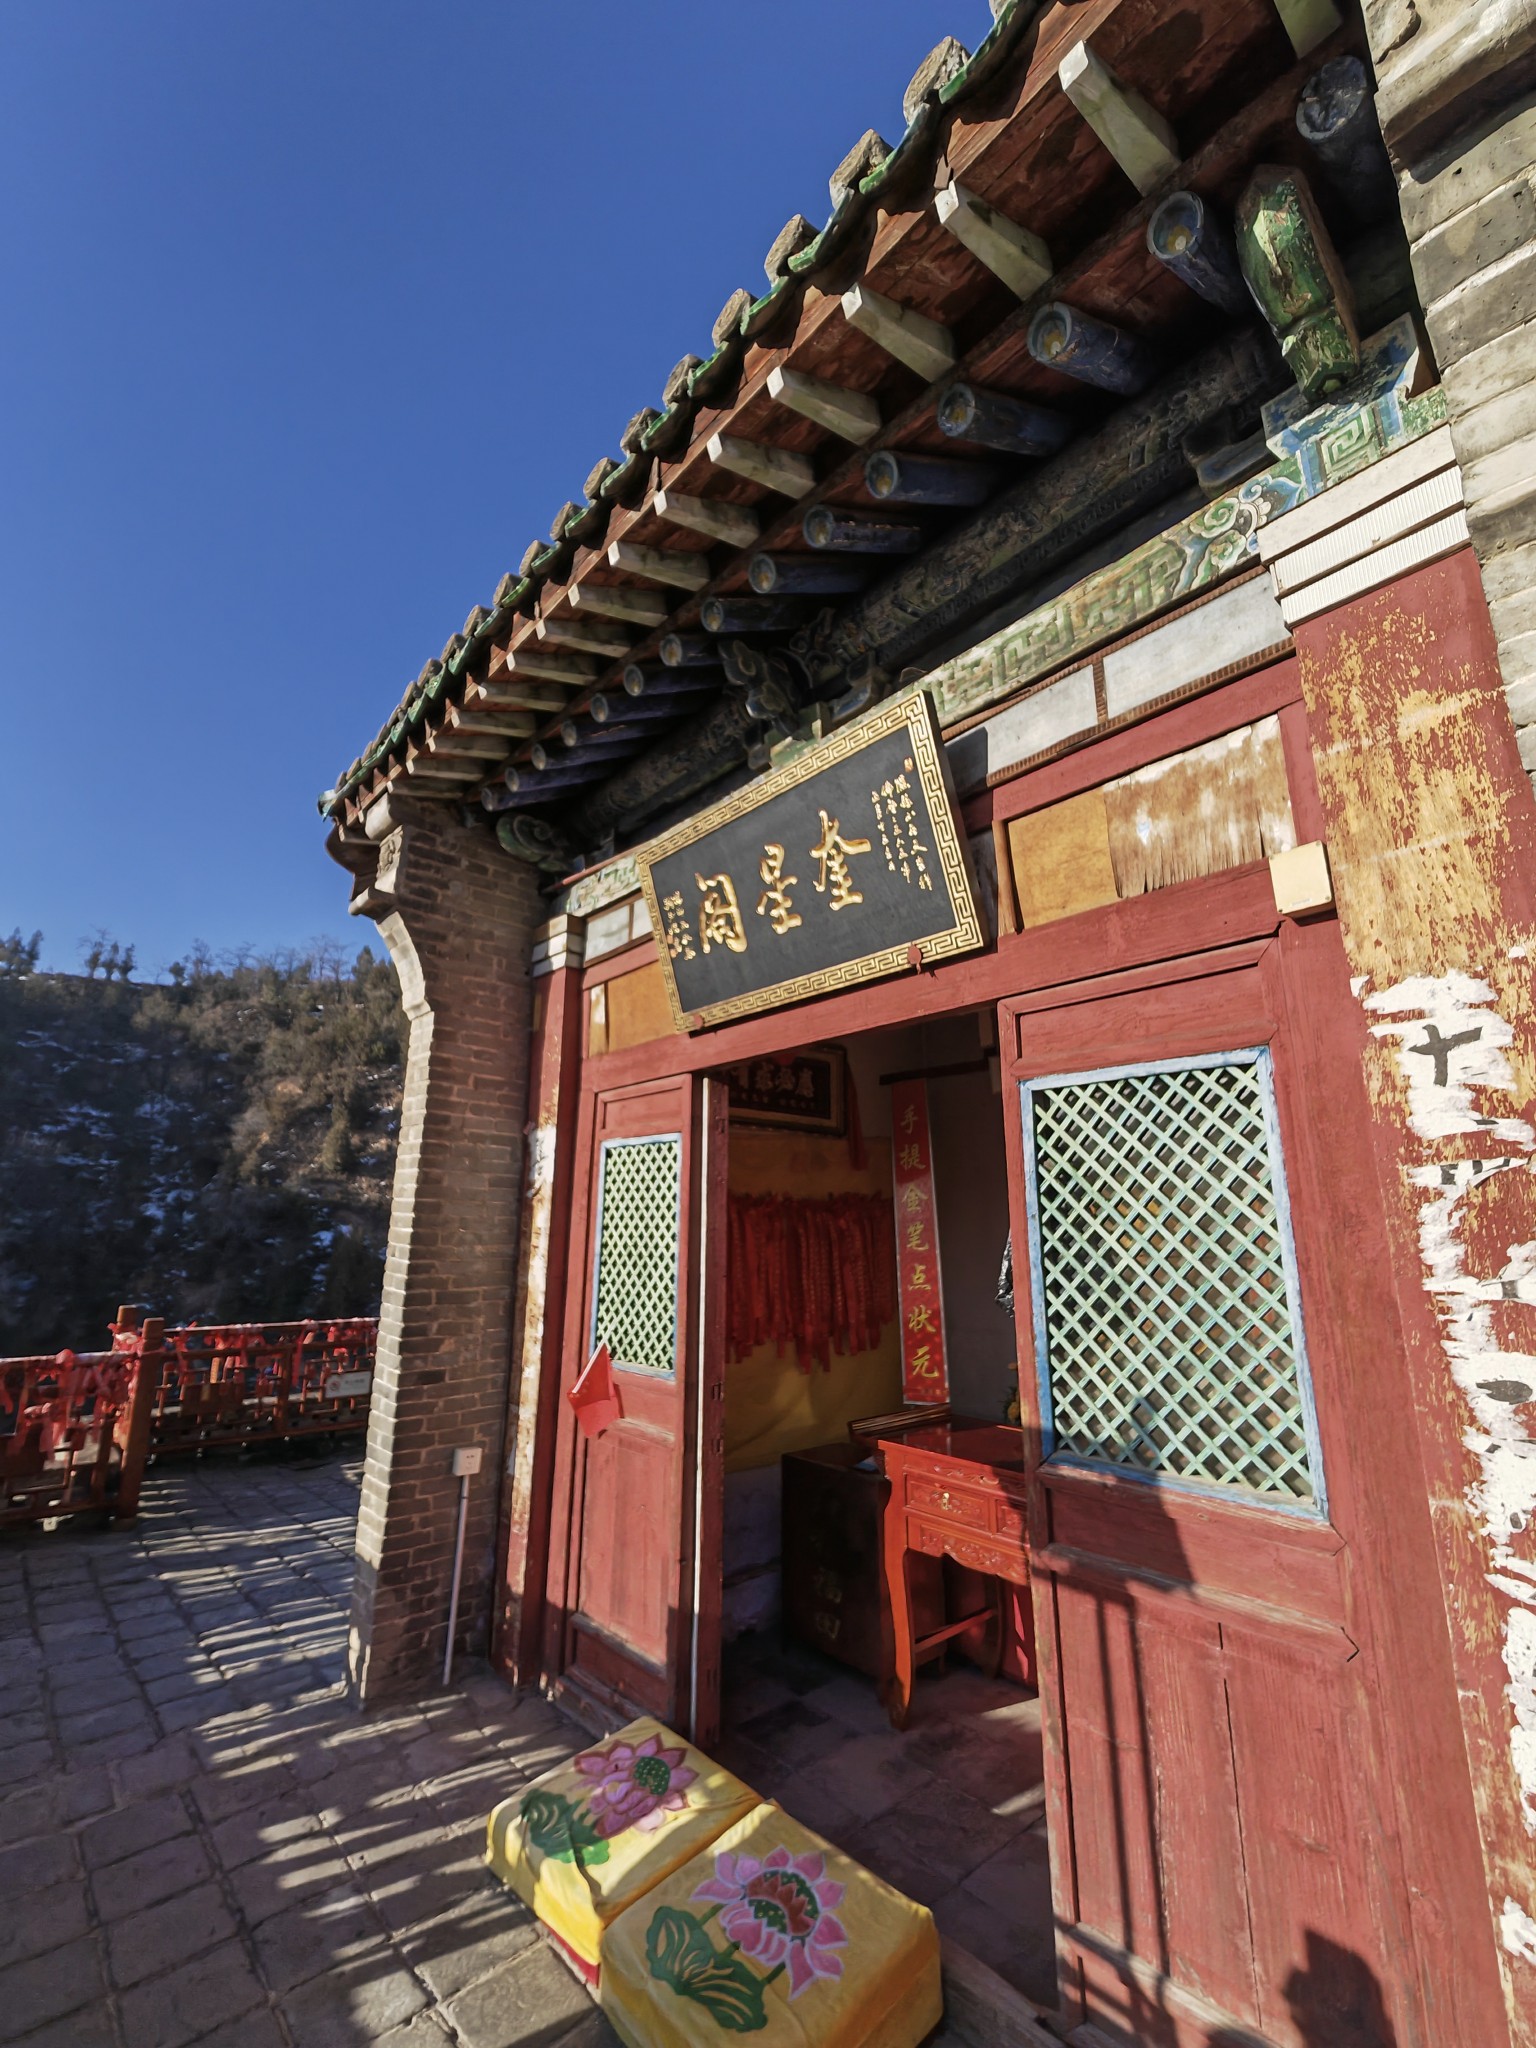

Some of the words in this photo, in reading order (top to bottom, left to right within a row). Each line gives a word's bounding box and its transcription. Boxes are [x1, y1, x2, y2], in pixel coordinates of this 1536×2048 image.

[899, 1104, 939, 1379] 手提金笔点状元
